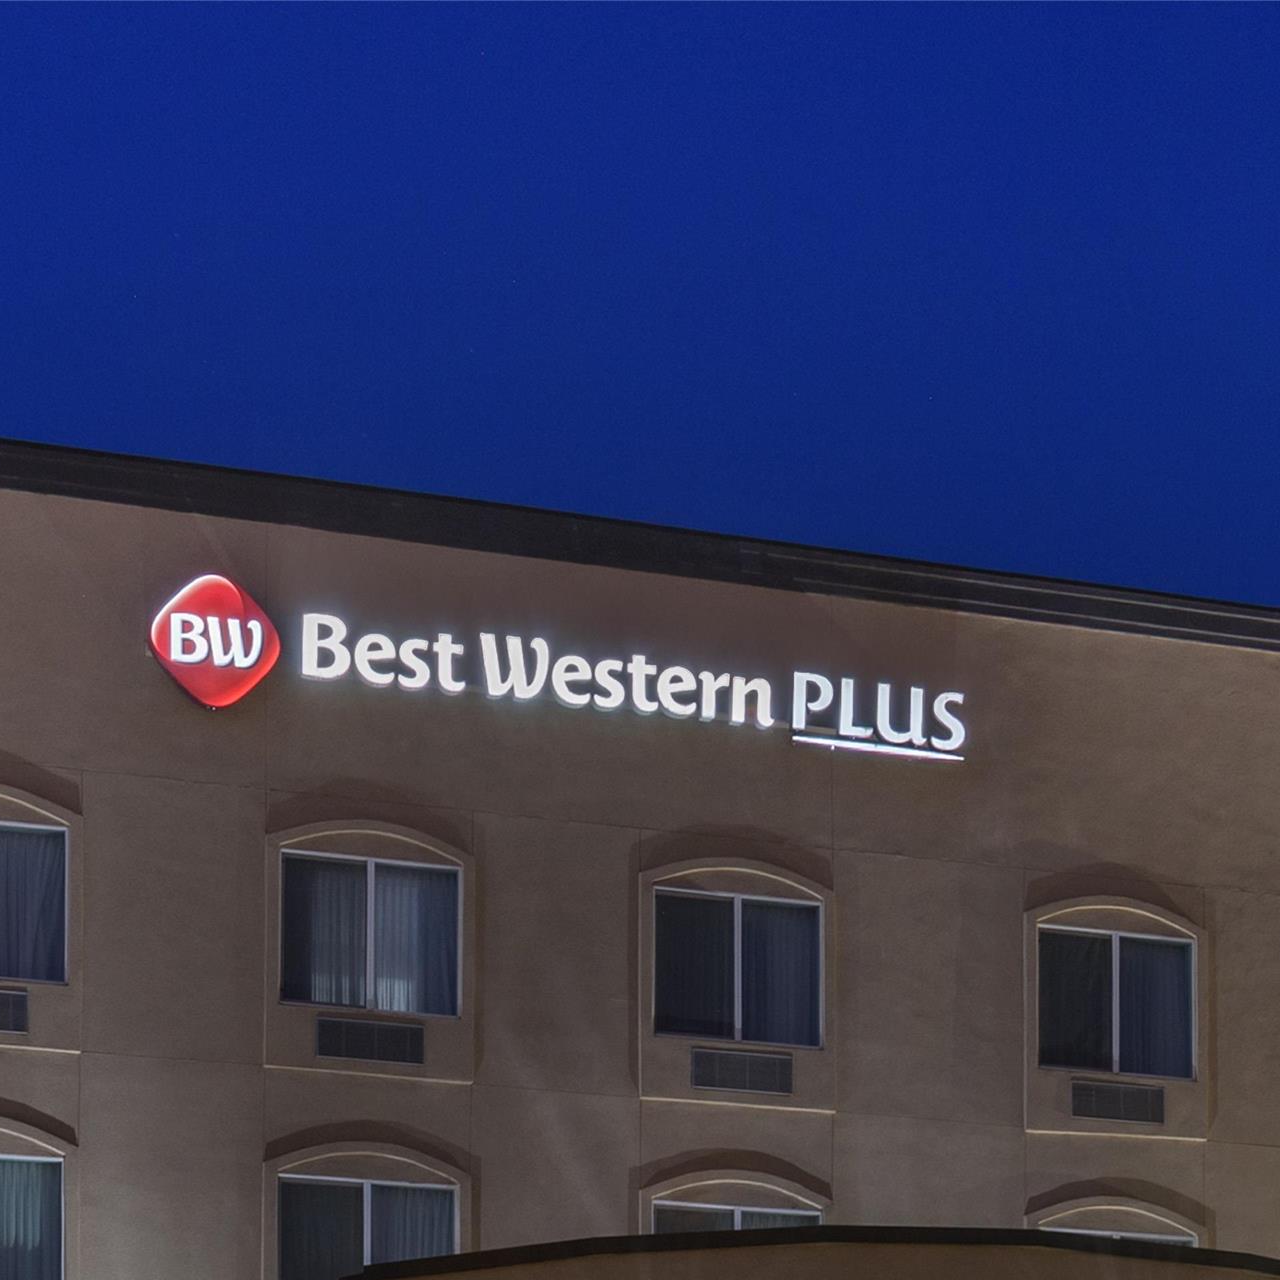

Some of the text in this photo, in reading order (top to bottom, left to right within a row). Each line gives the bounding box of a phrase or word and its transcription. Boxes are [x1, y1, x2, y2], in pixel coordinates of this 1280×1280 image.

[169, 612, 263, 669] BW
[301, 613, 967, 751] Best Western PLUS
